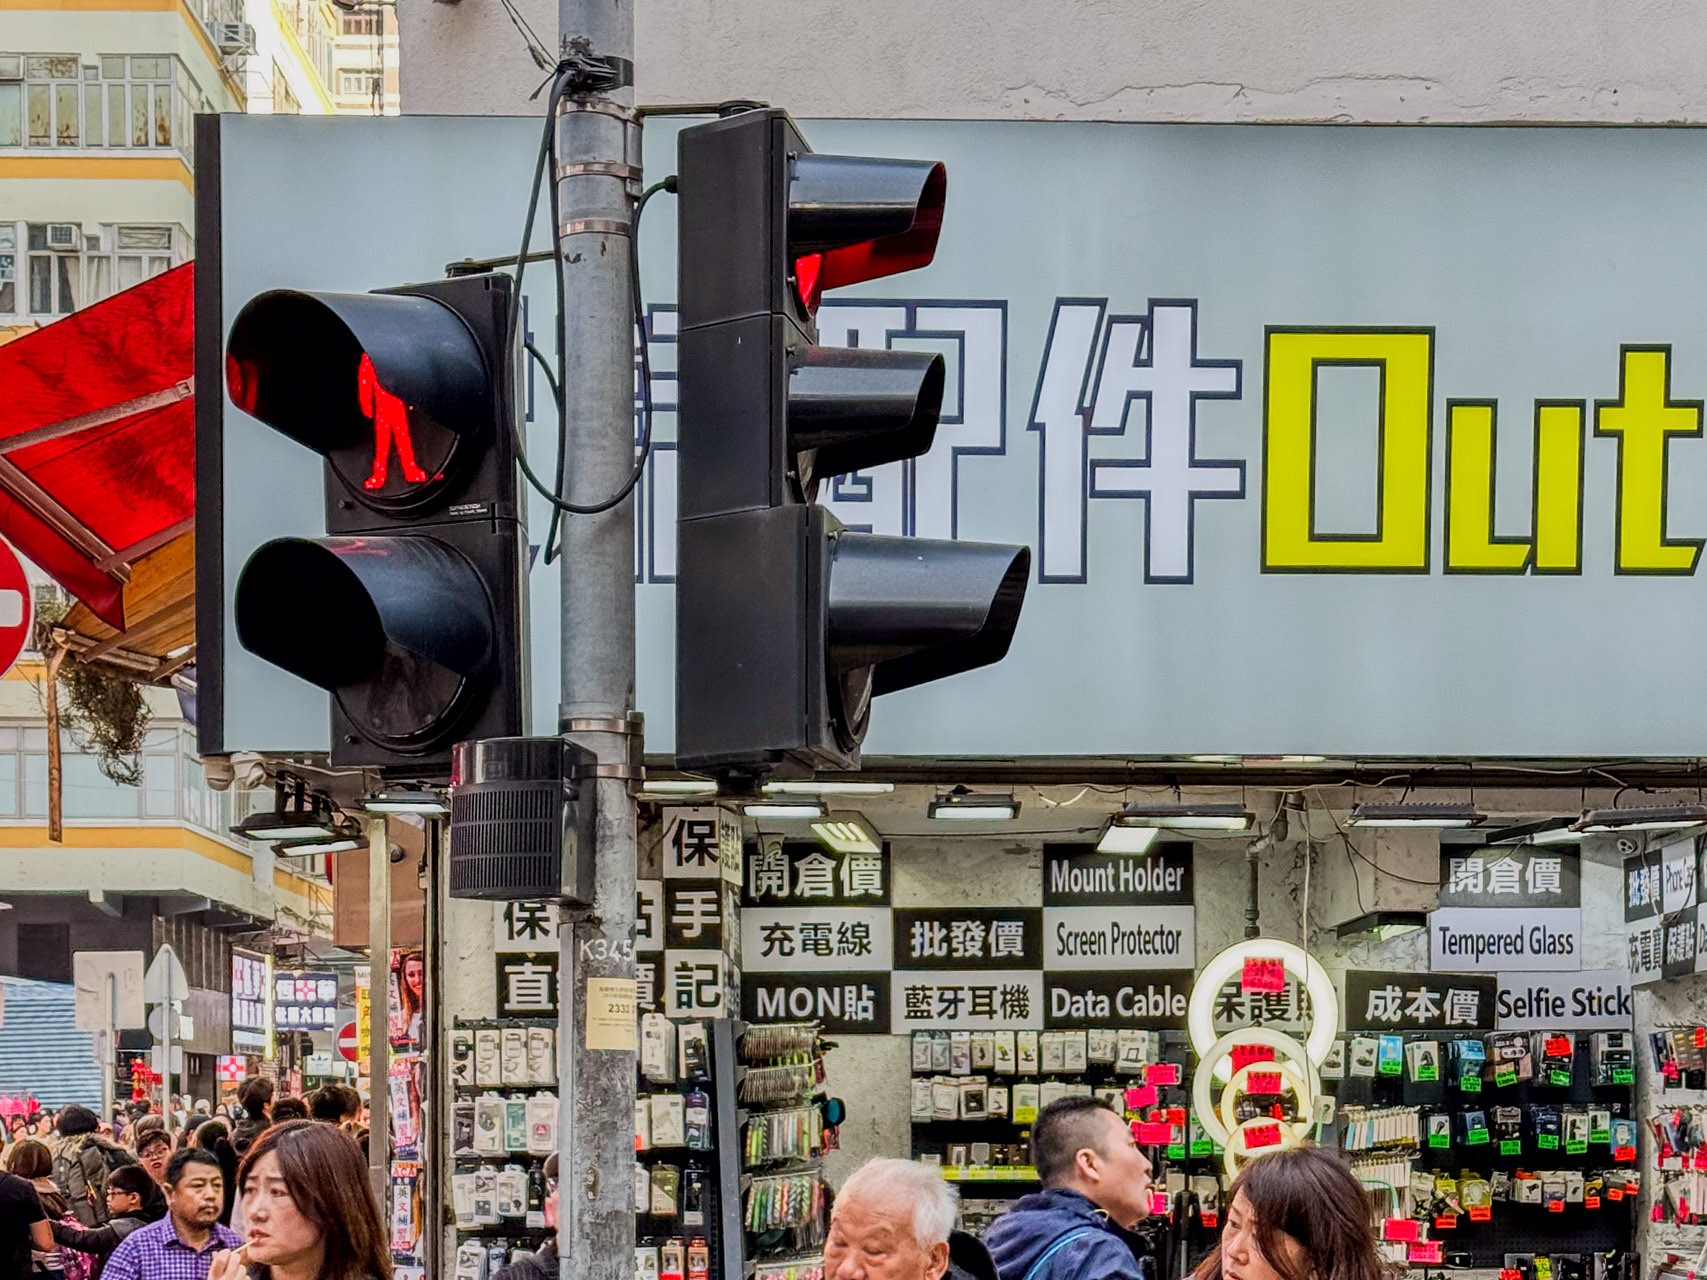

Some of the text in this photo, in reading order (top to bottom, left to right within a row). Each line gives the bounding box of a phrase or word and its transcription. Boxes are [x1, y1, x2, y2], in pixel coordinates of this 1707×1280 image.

[1260, 325, 1707, 575] Out
[750, 851, 883, 897] 開倉價
[1051, 857, 1184, 893] Mount Holder
[1450, 856, 1562, 895] 開倉價
[580, 938, 632, 962] K345
[760, 921, 872, 957] 充電線
[911, 921, 1024, 957] 批發價
[1056, 921, 1182, 956] Screen Protector
[1439, 925, 1574, 964] Tempered Glass
[757, 985, 875, 1021] MON貼
[904, 984, 1030, 1020] 藍牙耳機
[1051, 985, 1187, 1018] Data Cable
[1365, 984, 1480, 1027] 成本價
[1497, 985, 1632, 1019] Selfie Stick
